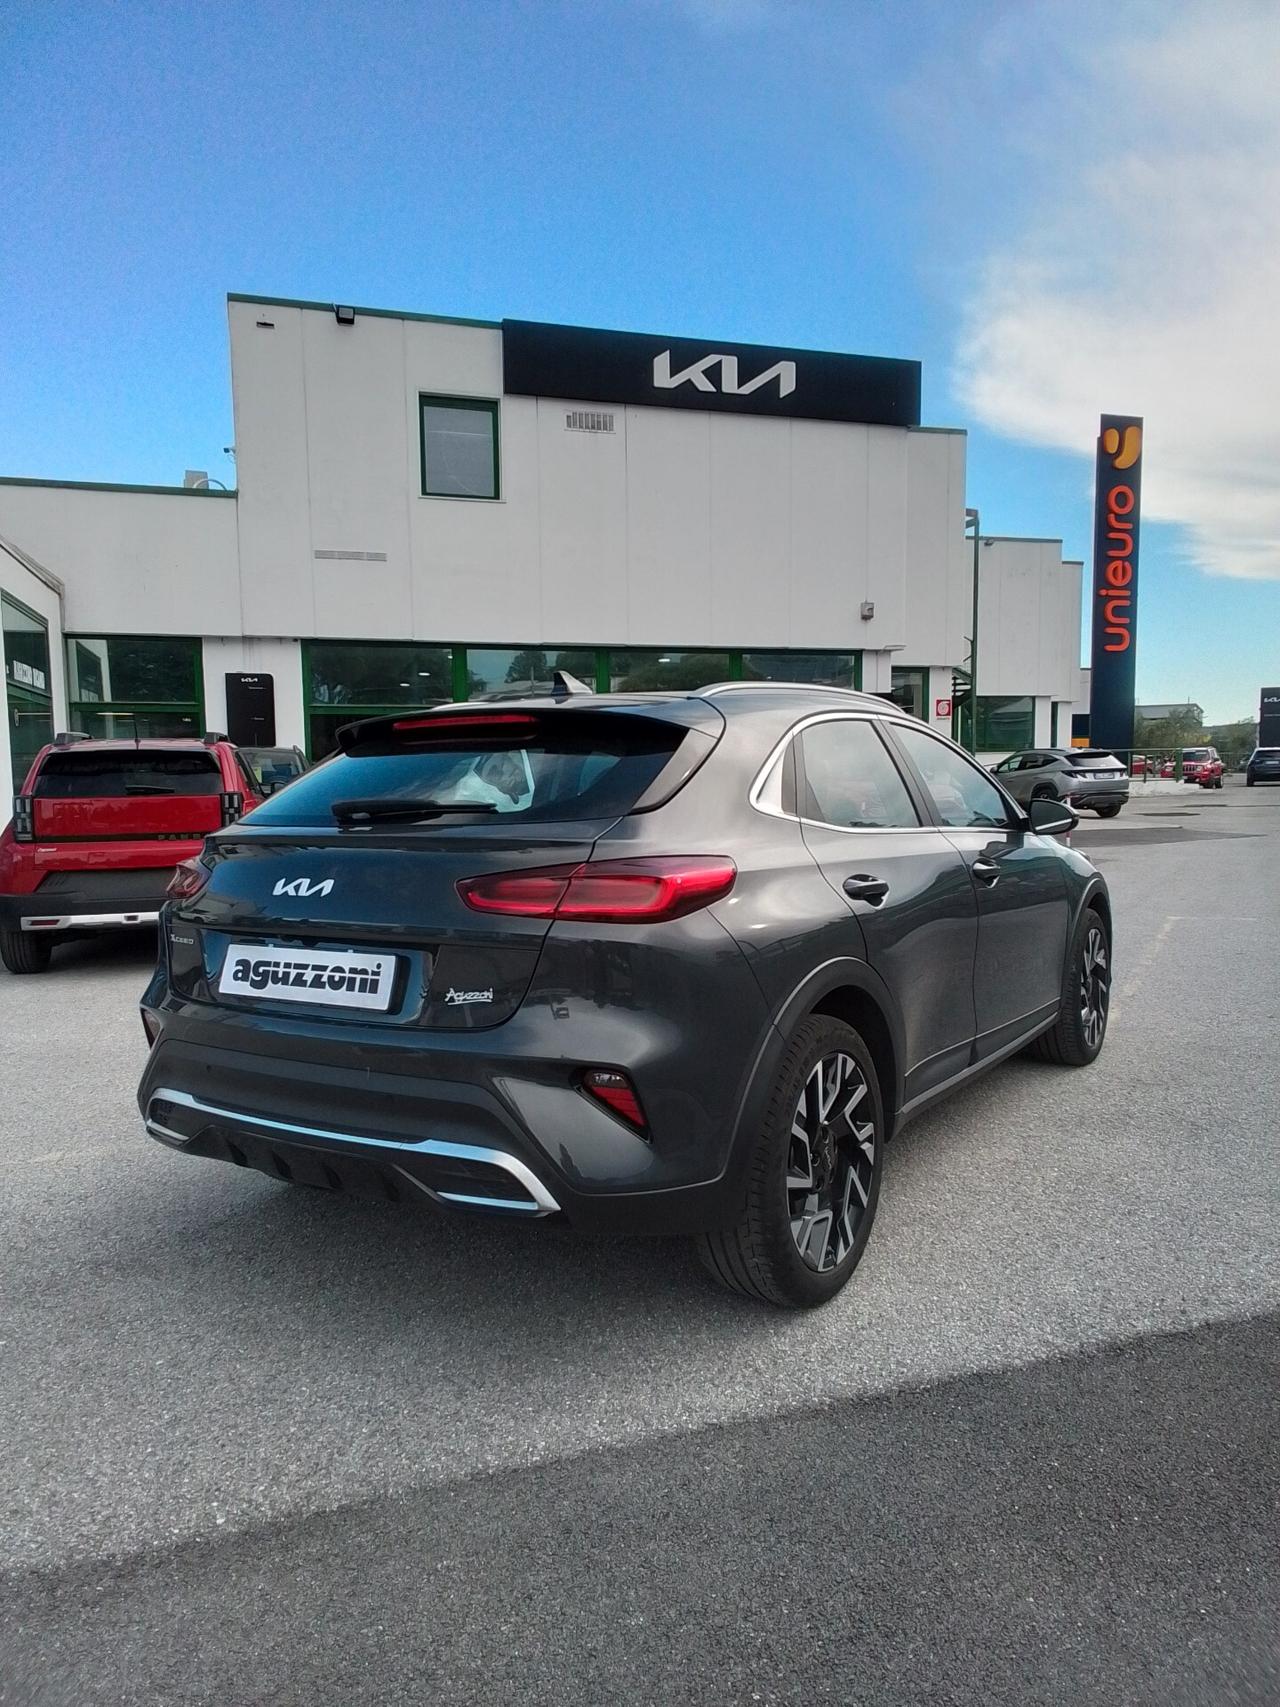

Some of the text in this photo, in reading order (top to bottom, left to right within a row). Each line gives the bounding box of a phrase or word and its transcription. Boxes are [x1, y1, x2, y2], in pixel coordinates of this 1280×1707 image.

[653, 349, 796, 399] KIA
[1099, 484, 1135, 652] unieuro
[272, 877, 335, 897] KIA
[232, 958, 382, 994] aguzzoni
